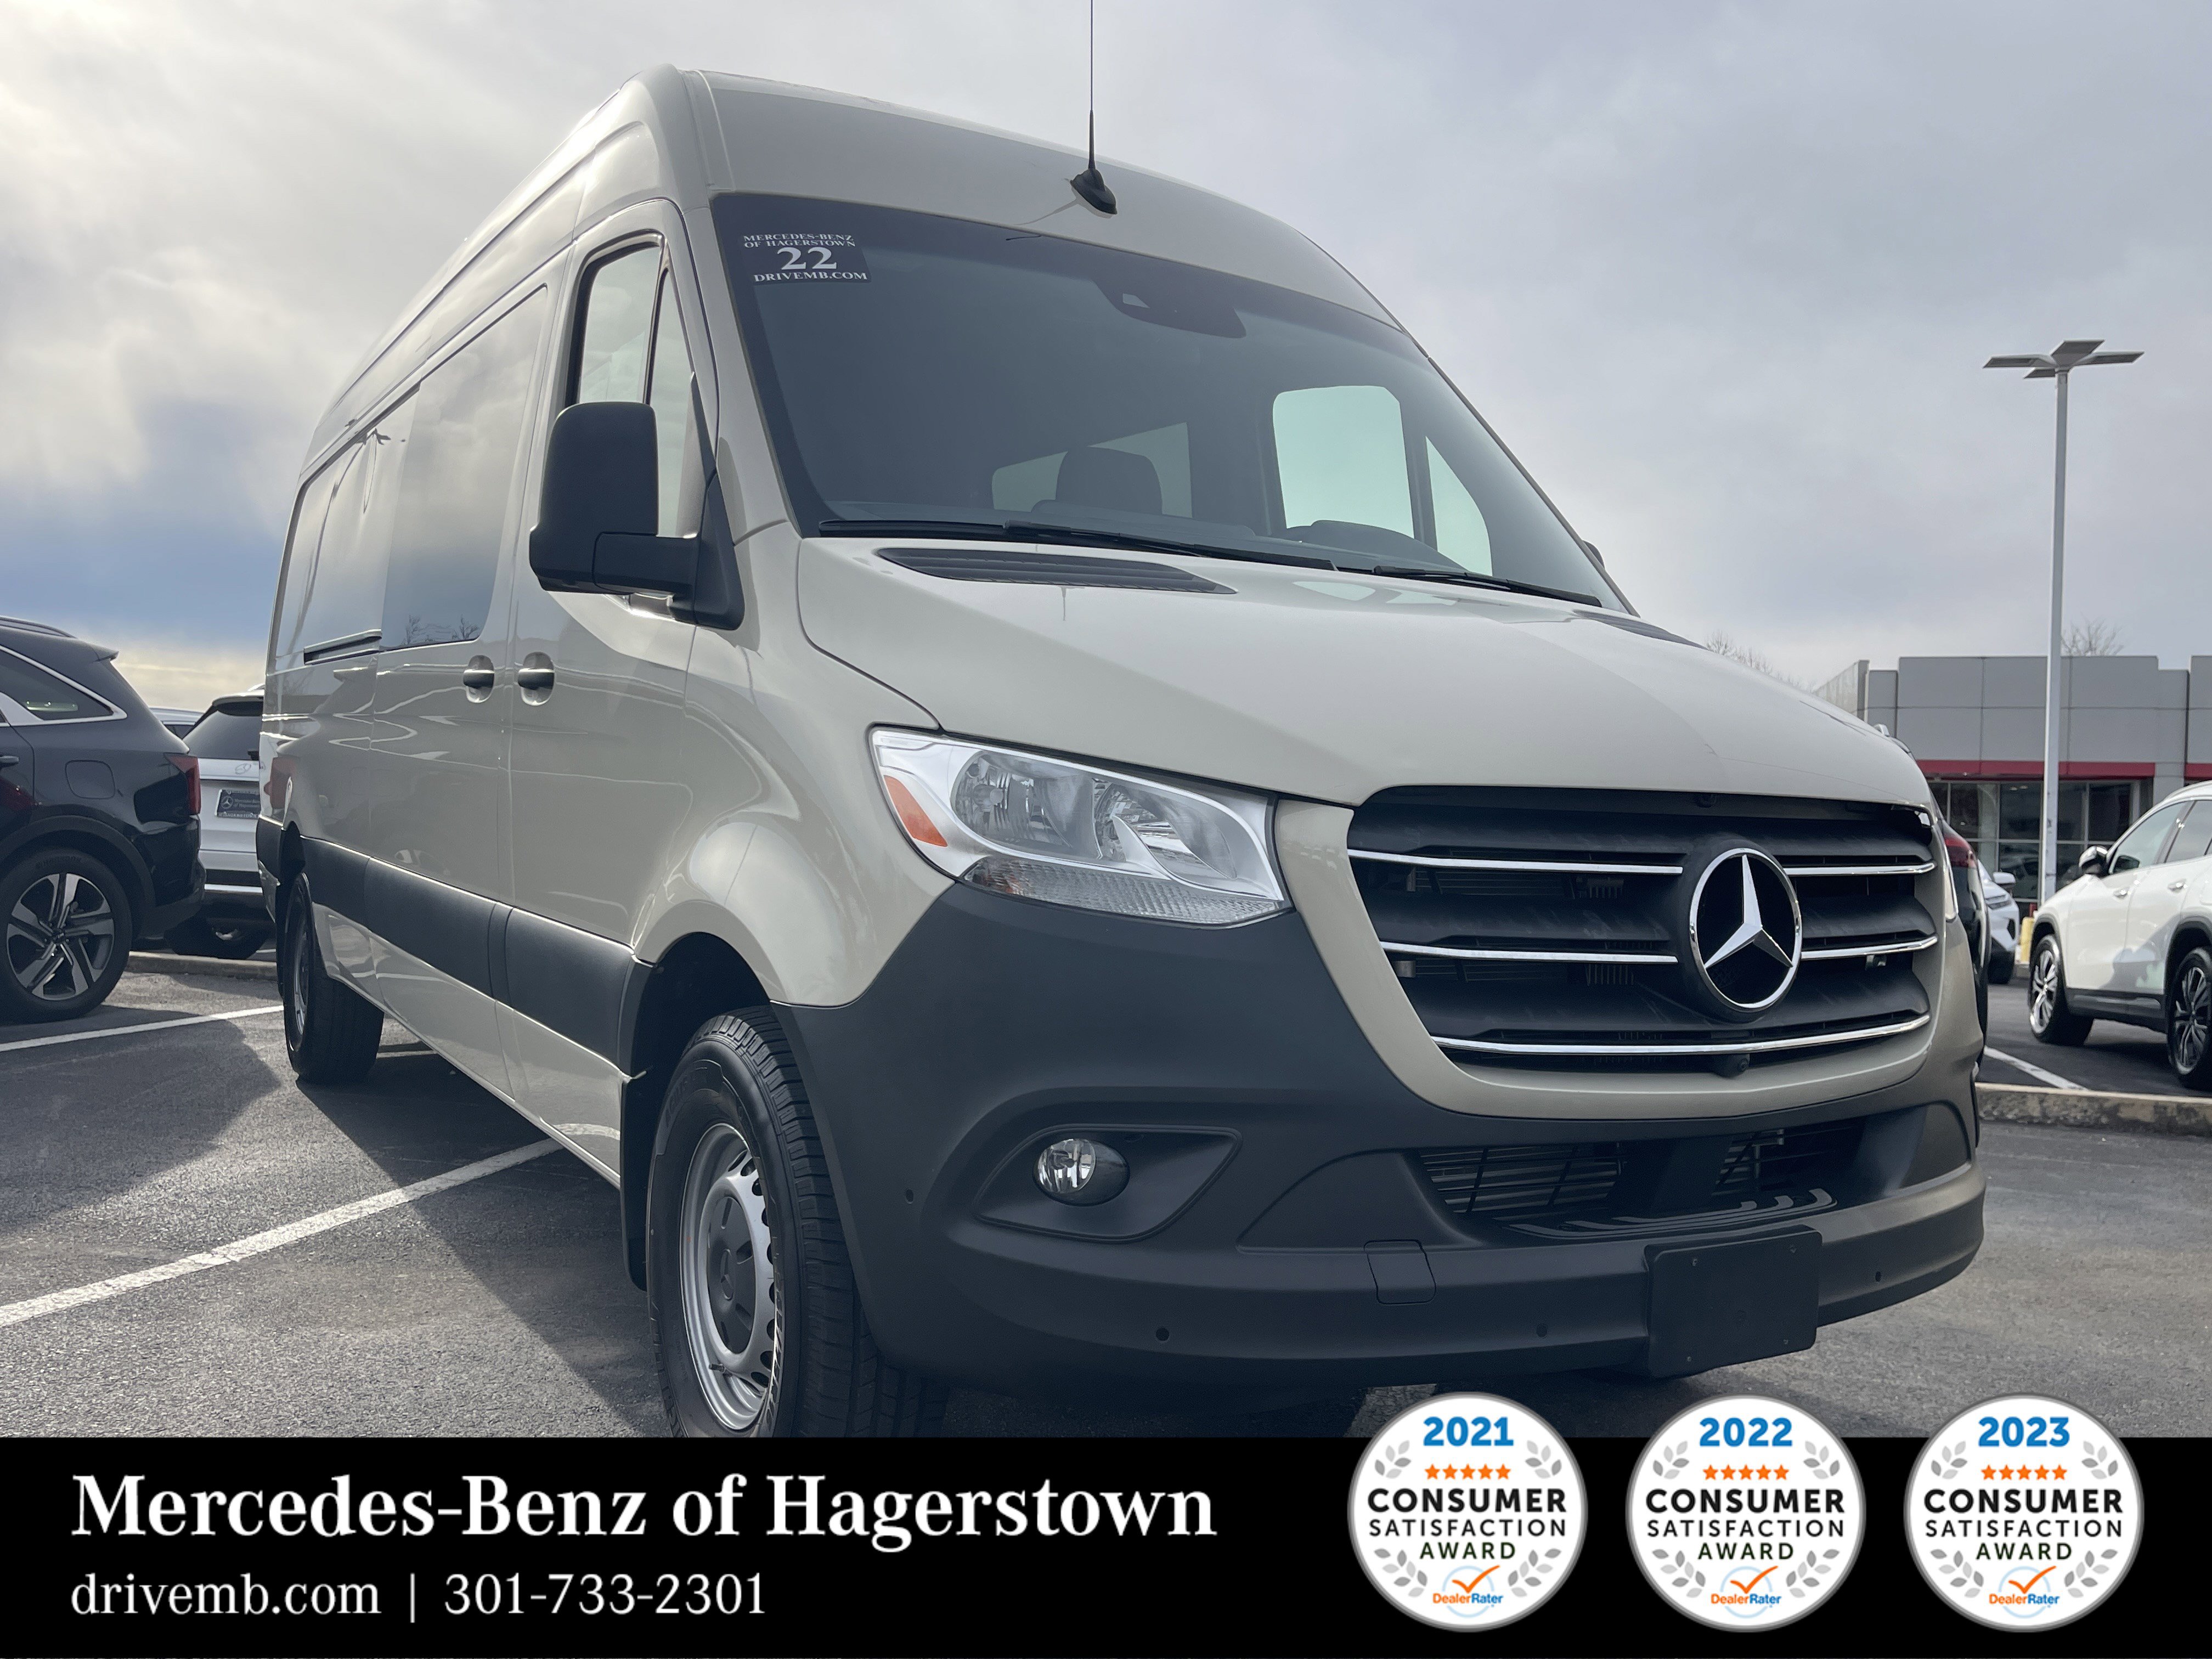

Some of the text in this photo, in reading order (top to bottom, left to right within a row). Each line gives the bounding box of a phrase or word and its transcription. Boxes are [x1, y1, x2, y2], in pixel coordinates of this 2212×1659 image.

[743, 233, 854, 241] MERCEDES-BENZ
[768, 239, 856, 247] HAGERSTOWN
[777, 247, 837, 270] 22
[754, 272, 868, 282] DRIVEMB.COM
